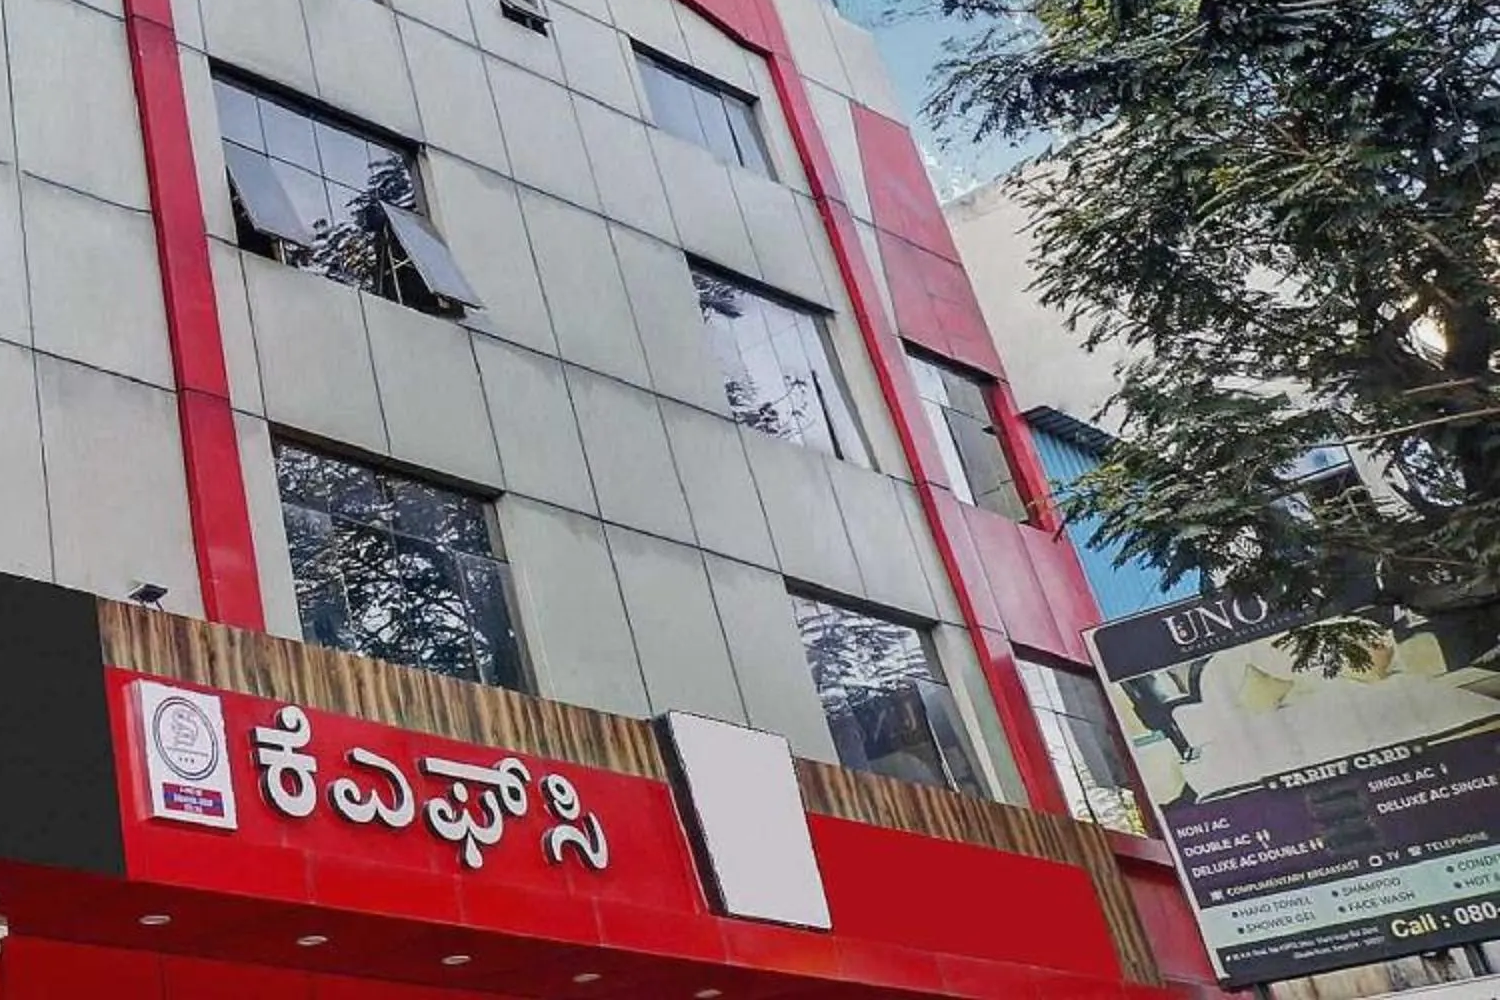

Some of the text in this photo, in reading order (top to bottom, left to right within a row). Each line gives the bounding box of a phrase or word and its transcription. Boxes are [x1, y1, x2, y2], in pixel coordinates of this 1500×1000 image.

[1162, 592, 1269, 646] UNO
[1280, 746, 1411, 788] TARIFF CARD
[1367, 766, 1436, 793] SINGLE AC
[1376, 774, 1499, 814] DELUXE AC SINGLE
[1211, 818, 1231, 831] AC
[1183, 833, 1251, 857] DOUBLE AC
[1386, 850, 1400, 861] TV
[1191, 841, 1309, 879] DELUXE AC DOUBLE
[1341, 876, 1401, 897] SHAMPOO
[1464, 873, 1491, 888] HOT
[1348, 891, 1416, 912] FACE WASH
[1391, 913, 1438, 938] Call
